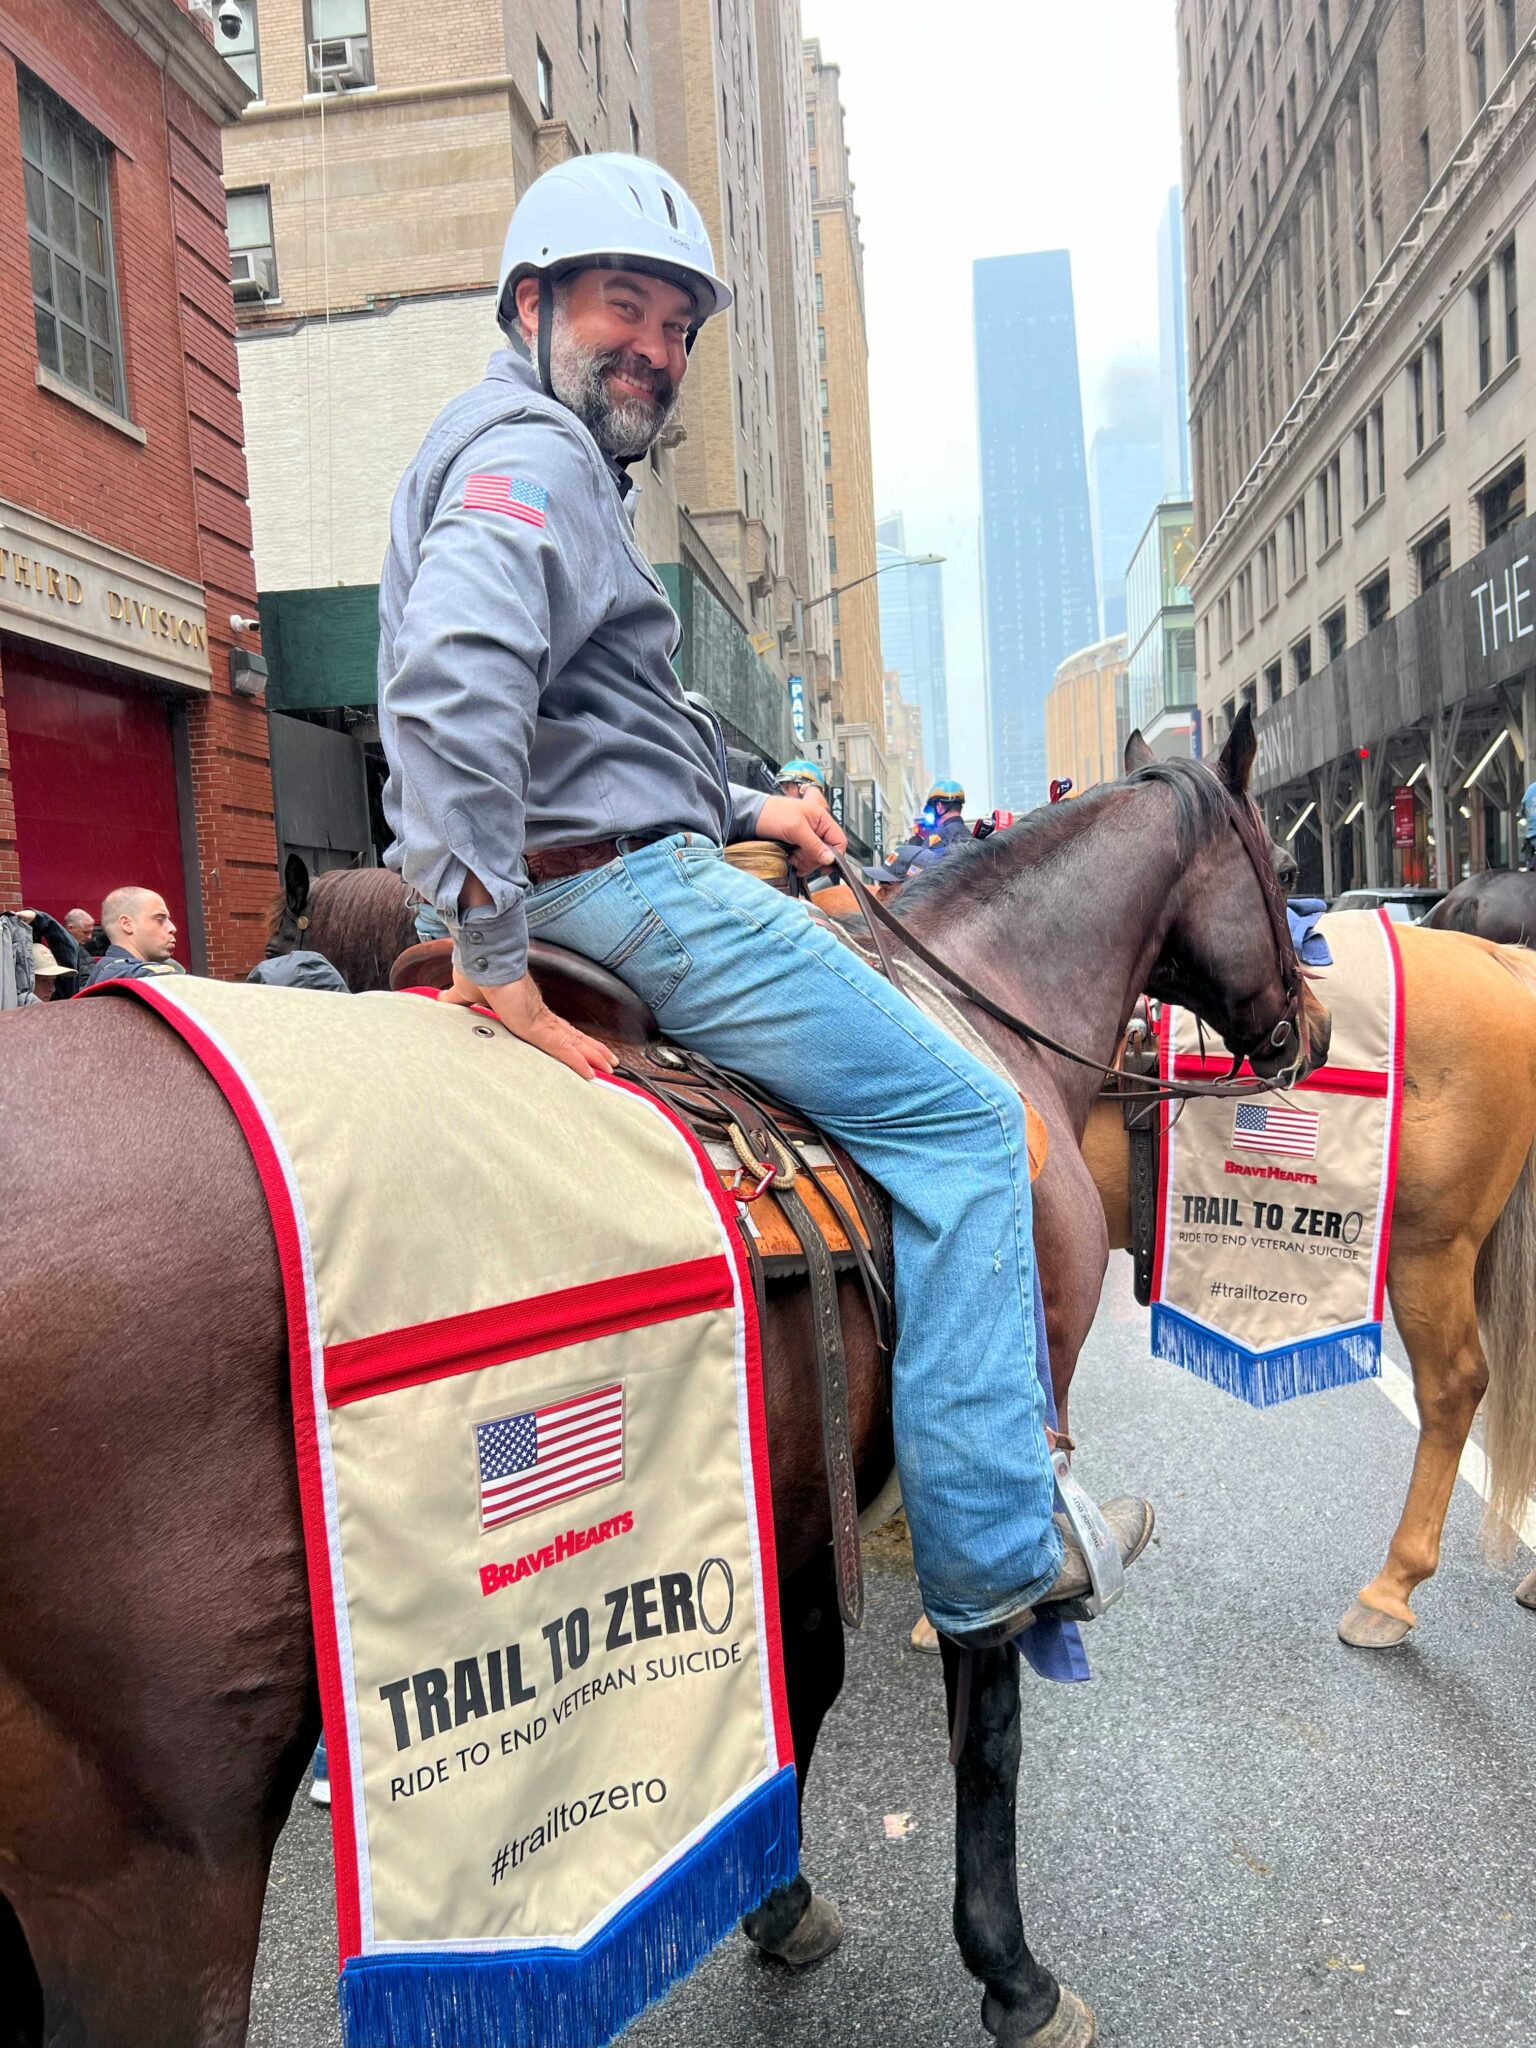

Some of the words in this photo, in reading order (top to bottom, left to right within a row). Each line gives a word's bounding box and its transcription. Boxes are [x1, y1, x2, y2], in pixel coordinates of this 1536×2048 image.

[0, 547, 82, 605] THIRD
[107, 590, 206, 650] DIVISION
[1471, 555, 1534, 656] THE
[1253, 721, 1282, 779] ENN
[832, 788, 843, 825] PAR
[874, 812, 883, 842] PARK
[1179, 1232, 1201, 1243] RIDE
[1203, 1233, 1218, 1244] TO
[1222, 1234, 1247, 1246] END
[1251, 1237, 1305, 1254] VETERAN
[1309, 1244, 1360, 1260] SUICIDE
[1182, 1195, 1242, 1227] TRAIL
[1253, 1200, 1283, 1231] TO
[1291, 1210, 1364, 1244] ZERO
[1210, 1281, 1308, 1306] #trailtozero
[379, 1645, 536, 1752] TRAIL
[541, 1606, 590, 1685] TO
[604, 1557, 734, 1652] ZERO
[390, 1758, 450, 1802] RIDE
[456, 1741, 490, 1773] TO
[501, 1716, 547, 1756] END
[552, 1664, 636, 1726] VETERAN
[646, 1642, 742, 1682] SUICIDE
[491, 1777, 667, 1886] #trailtozero
